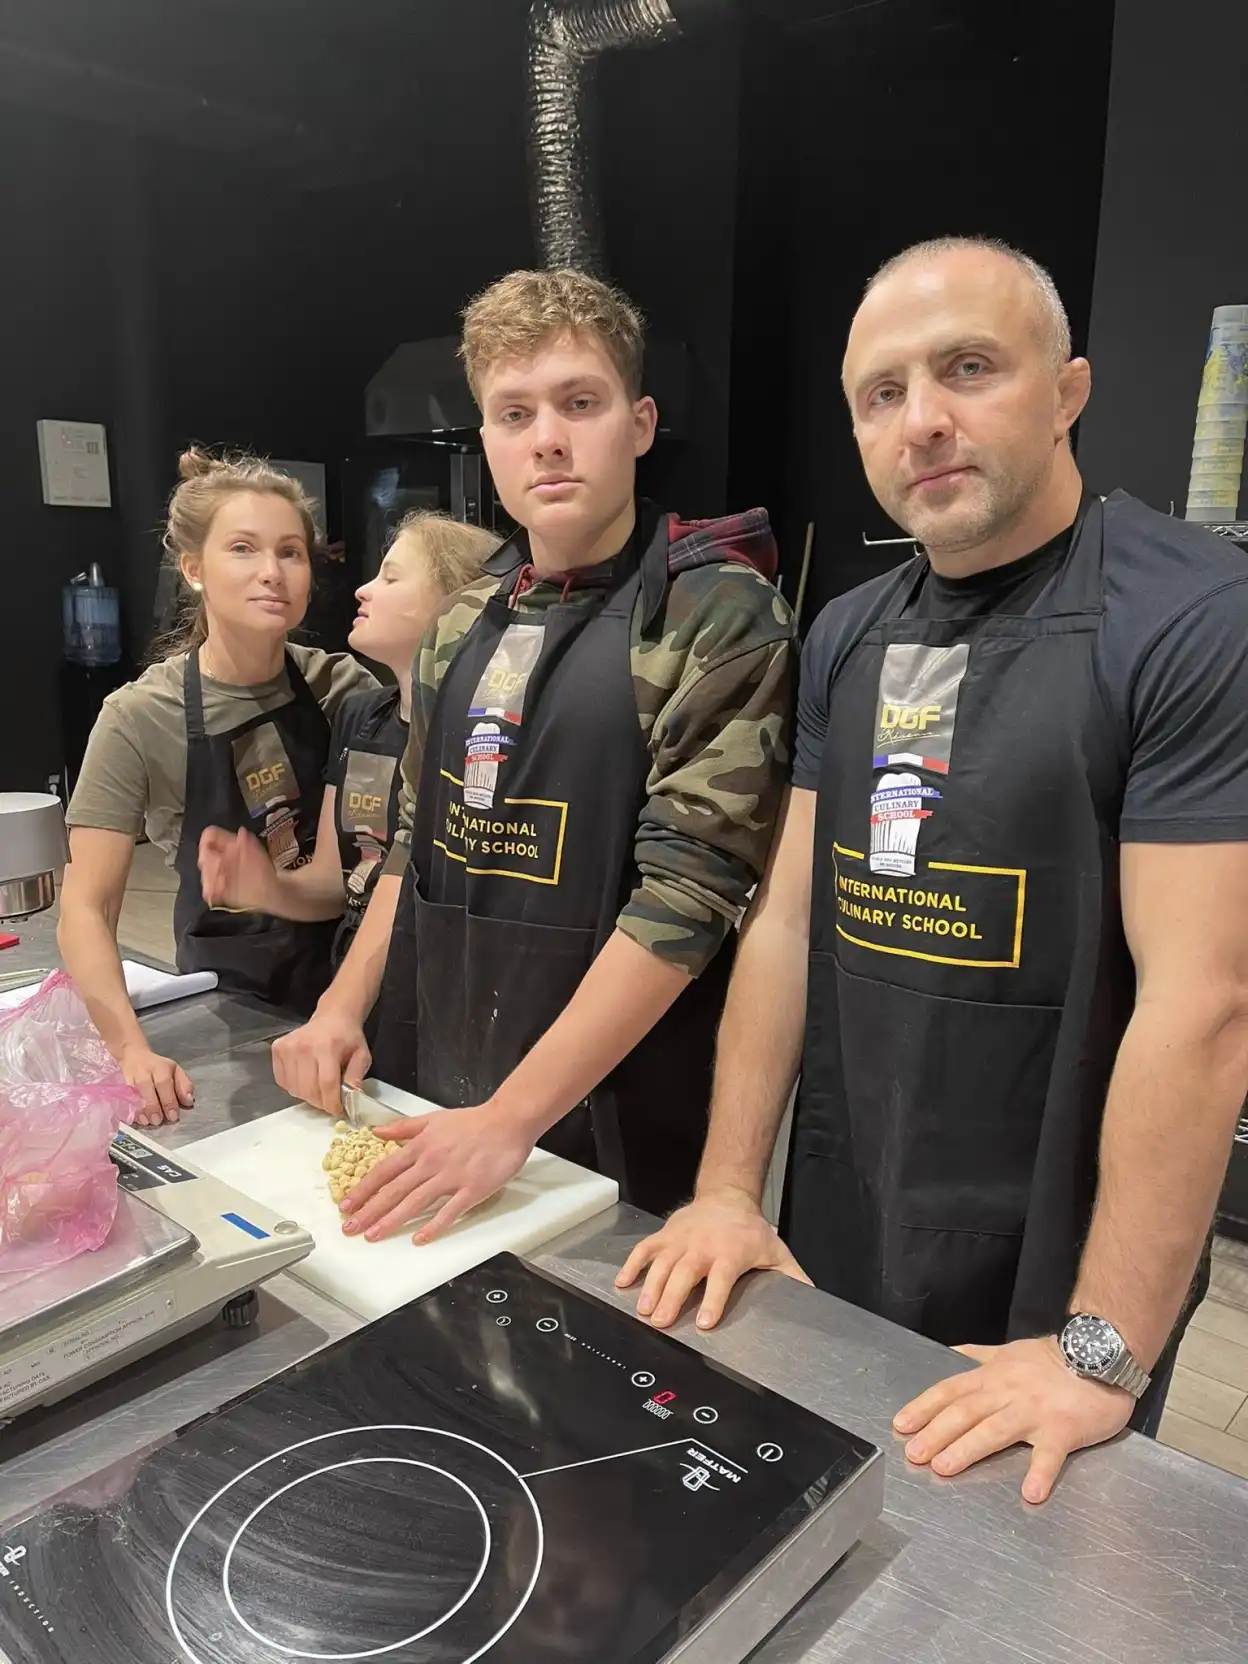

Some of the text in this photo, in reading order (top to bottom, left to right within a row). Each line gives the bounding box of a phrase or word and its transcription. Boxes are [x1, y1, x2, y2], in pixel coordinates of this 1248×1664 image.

[881, 704, 941, 730] DGF
[246, 763, 285, 790] DGF
[349, 792, 381, 811] DGF
[875, 800, 919, 812] CULINARY
[877, 810, 916, 821] SCHOOL
[481, 841, 539, 859] SCHOOL
[902, 914, 982, 939] SCHOOL
[157, 1164, 182, 1177] CAS
[687, 1448, 741, 1483] MATFER
